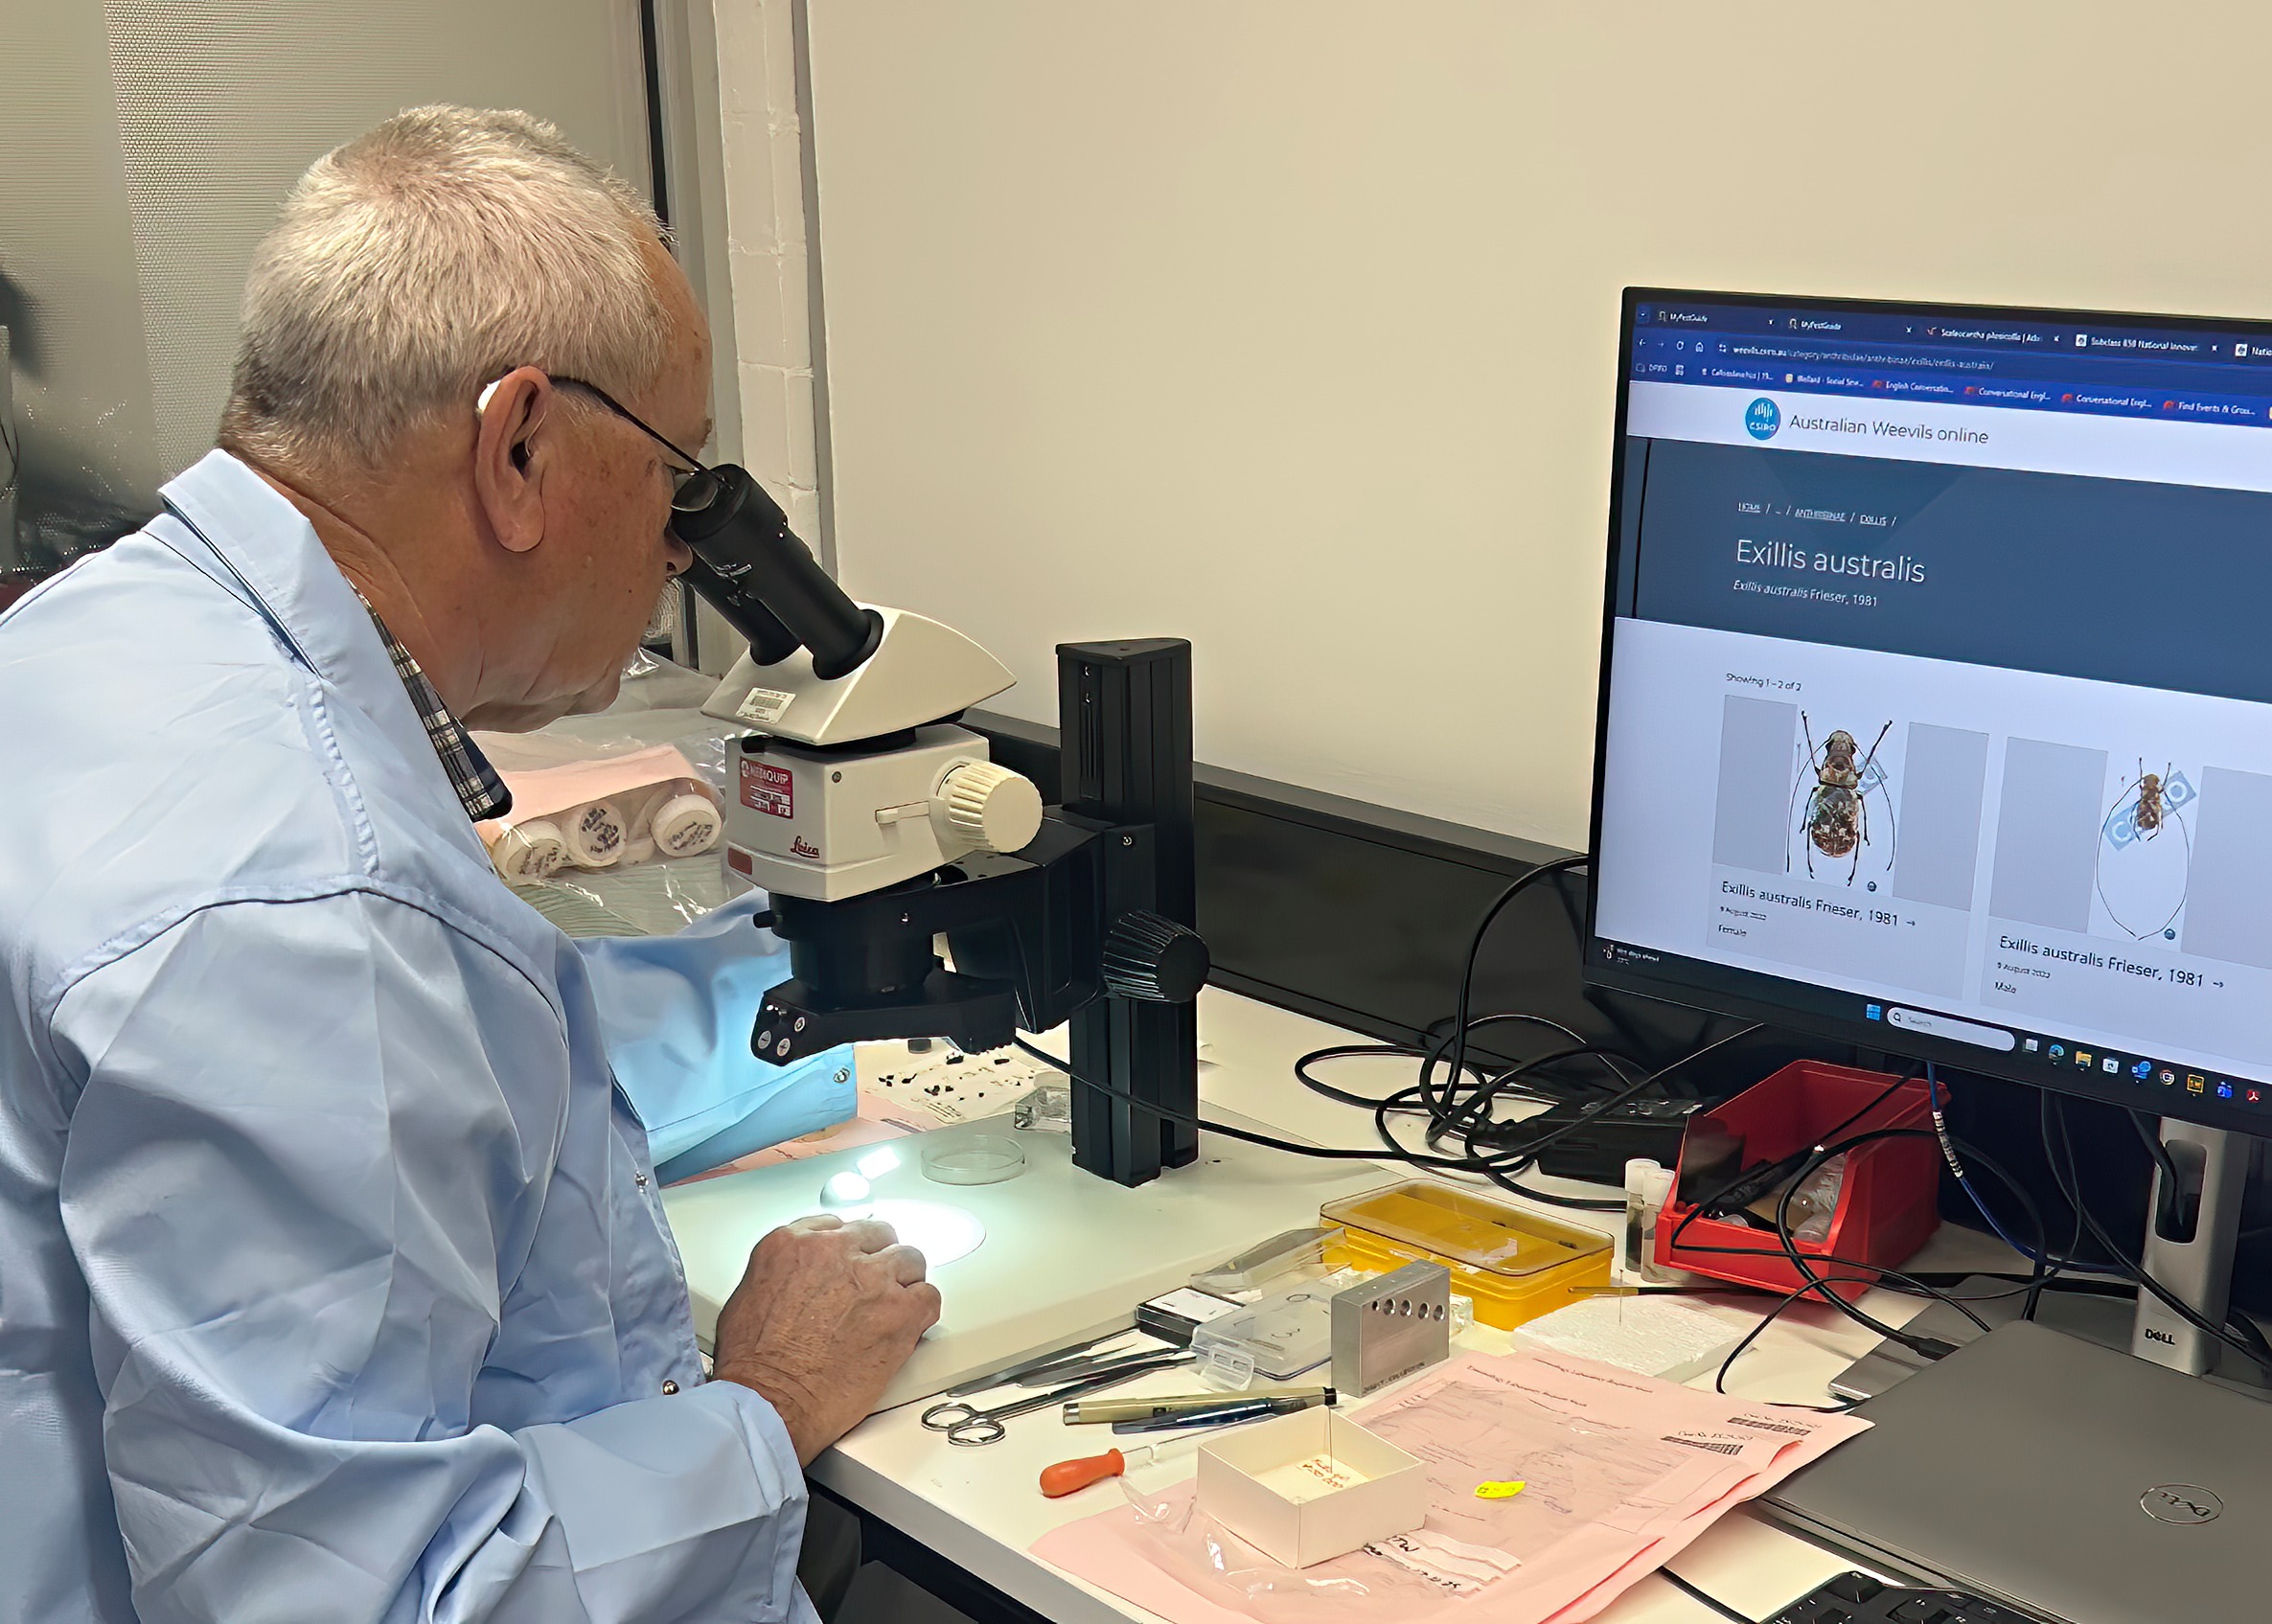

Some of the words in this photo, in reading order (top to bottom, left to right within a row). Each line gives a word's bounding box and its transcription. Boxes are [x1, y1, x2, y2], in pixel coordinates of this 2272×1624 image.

[1979, 387, 2030, 399] Conversational
[2077, 394, 2129, 406] Conversational
[2178, 401, 2194, 411] Find
[2196, 402, 2220, 413] Events
[1749, 422, 1777, 431] CSIRO
[1789, 415, 1868, 435] Australian
[1872, 421, 1934, 440] Weevils
[1937, 425, 1989, 445] online
[1736, 538, 1806, 569] Exillis
[1813, 552, 1926, 583] australis
[1733, 580, 1761, 593] Exillis
[1763, 584, 1808, 599] australis
[1810, 588, 1849, 605] Frieser,
[1852, 593, 1877, 607] 1981
[1726, 673, 1764, 688] Showing
[790, 835, 820, 859] Leica
[1722, 881, 1756, 898] Exillis
[1759, 889, 1812, 909] australis
[1816, 899, 1863, 921] Frieser,
[1869, 909, 1898, 926] 1981
[2000, 935, 2038, 955] Exillis
[2042, 944, 2103, 968] australis
[2108, 956, 2163, 981] Frieser,
[2169, 969, 2204, 987] 1981
[2146, 1328, 2176, 1346] DELL
